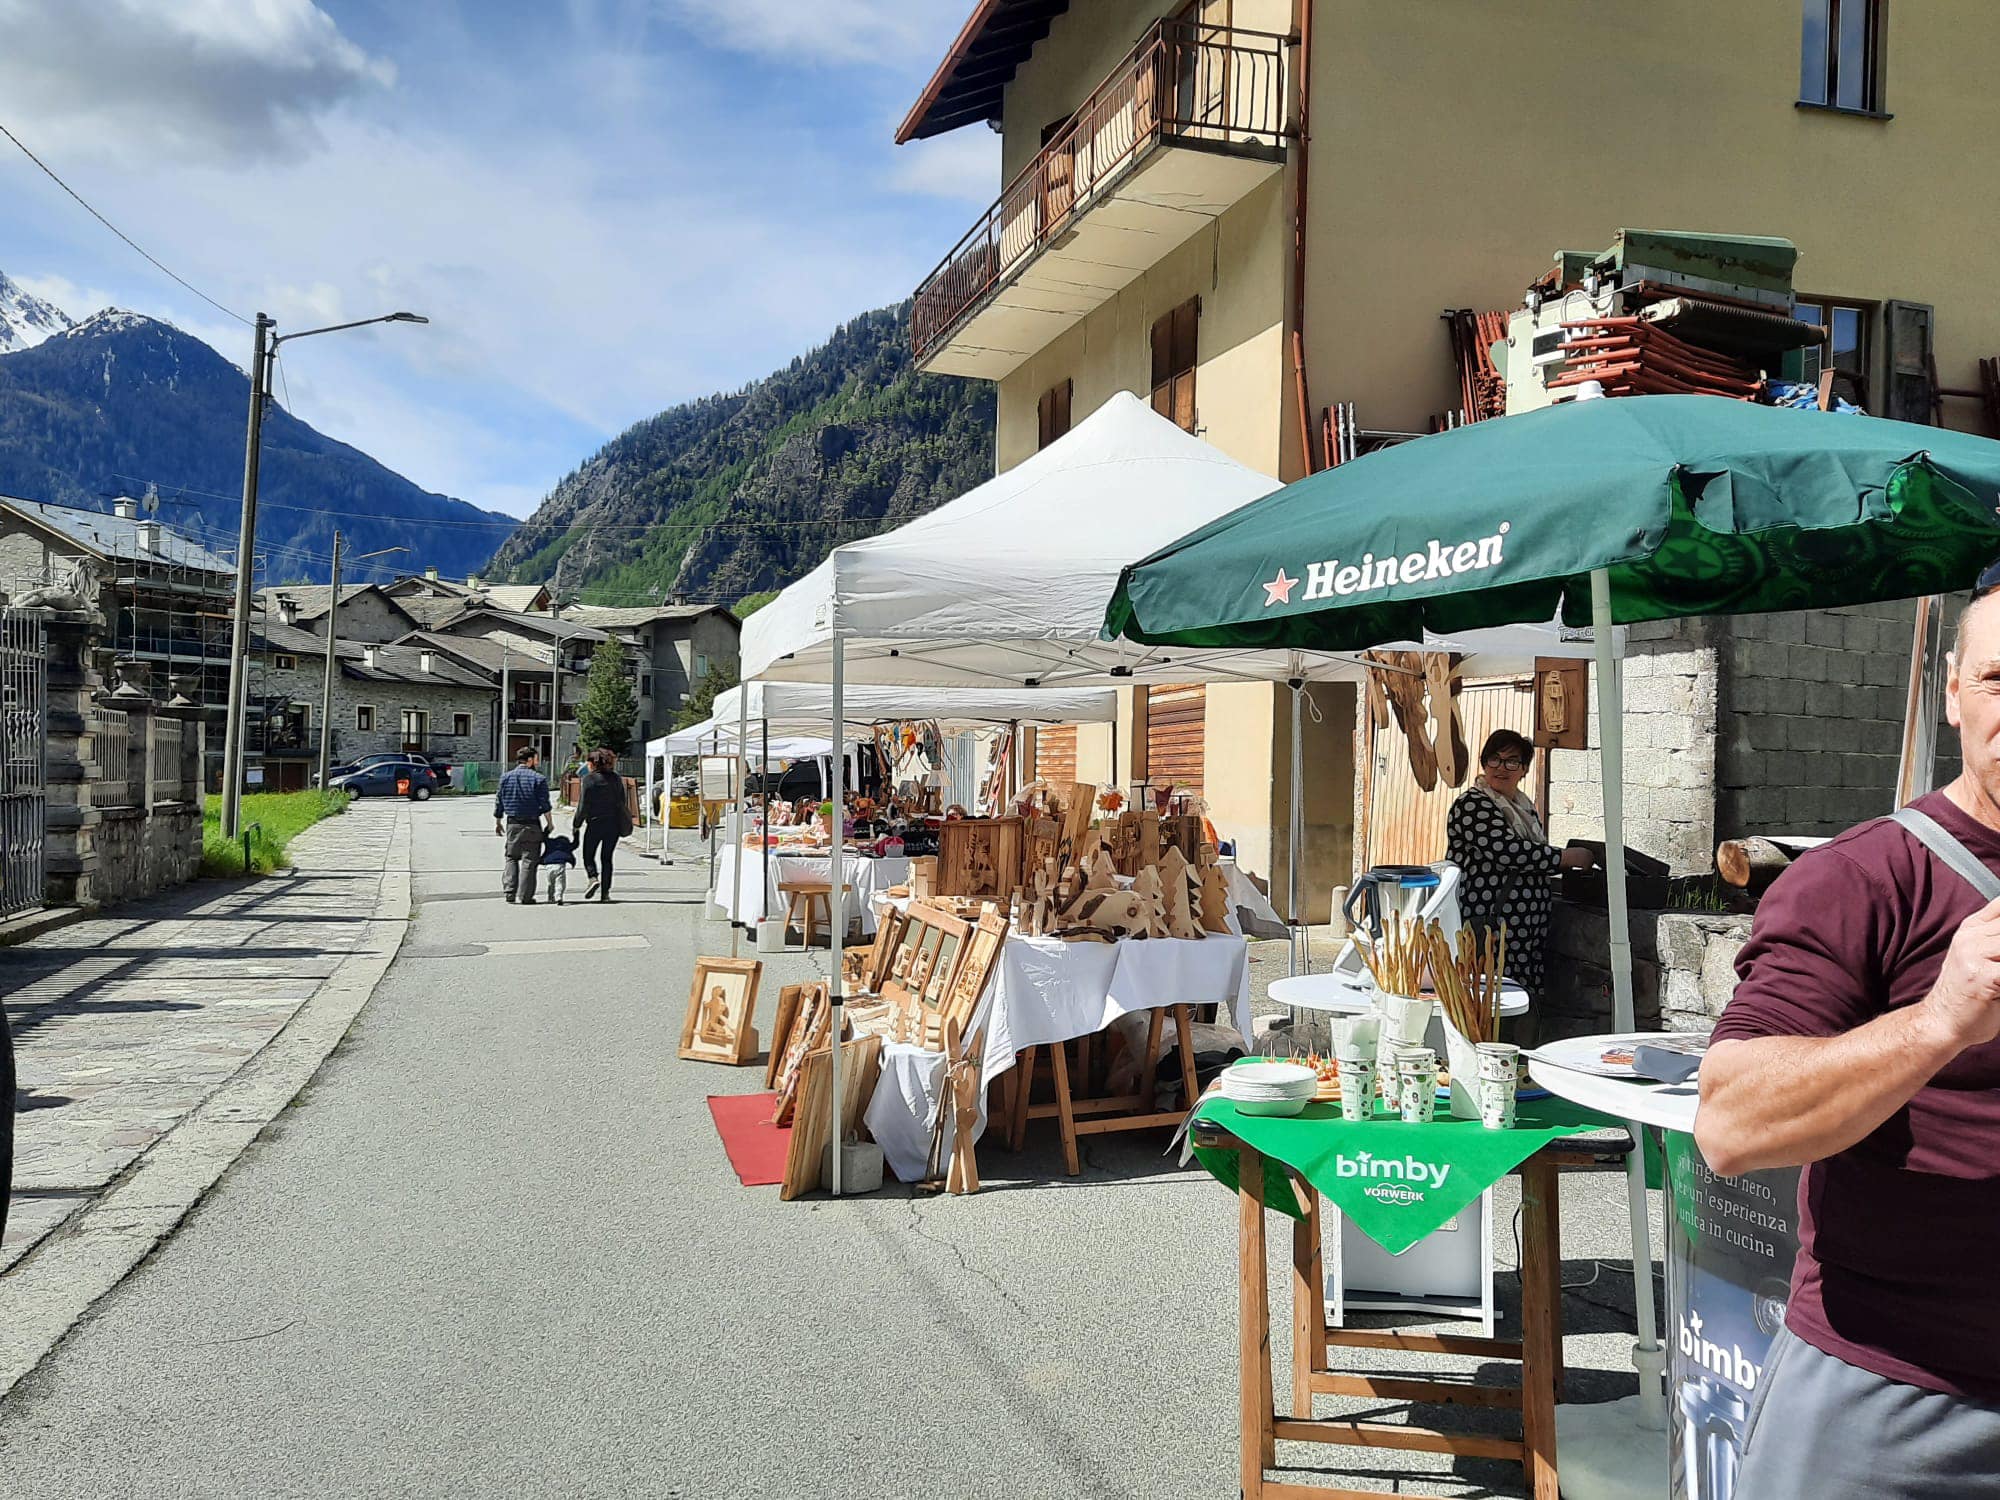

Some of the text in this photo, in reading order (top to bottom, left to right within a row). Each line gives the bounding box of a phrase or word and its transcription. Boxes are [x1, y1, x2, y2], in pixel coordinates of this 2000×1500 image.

[1302, 533, 1504, 601] Heineken
[1336, 1151, 1450, 1189] bimby
[1364, 1186, 1425, 1202] VORWERK
[1680, 1205, 1775, 1258] unica in cucina
[1690, 1186, 1788, 1234] un'esperienza
[1680, 1309, 1763, 1391] bimb
